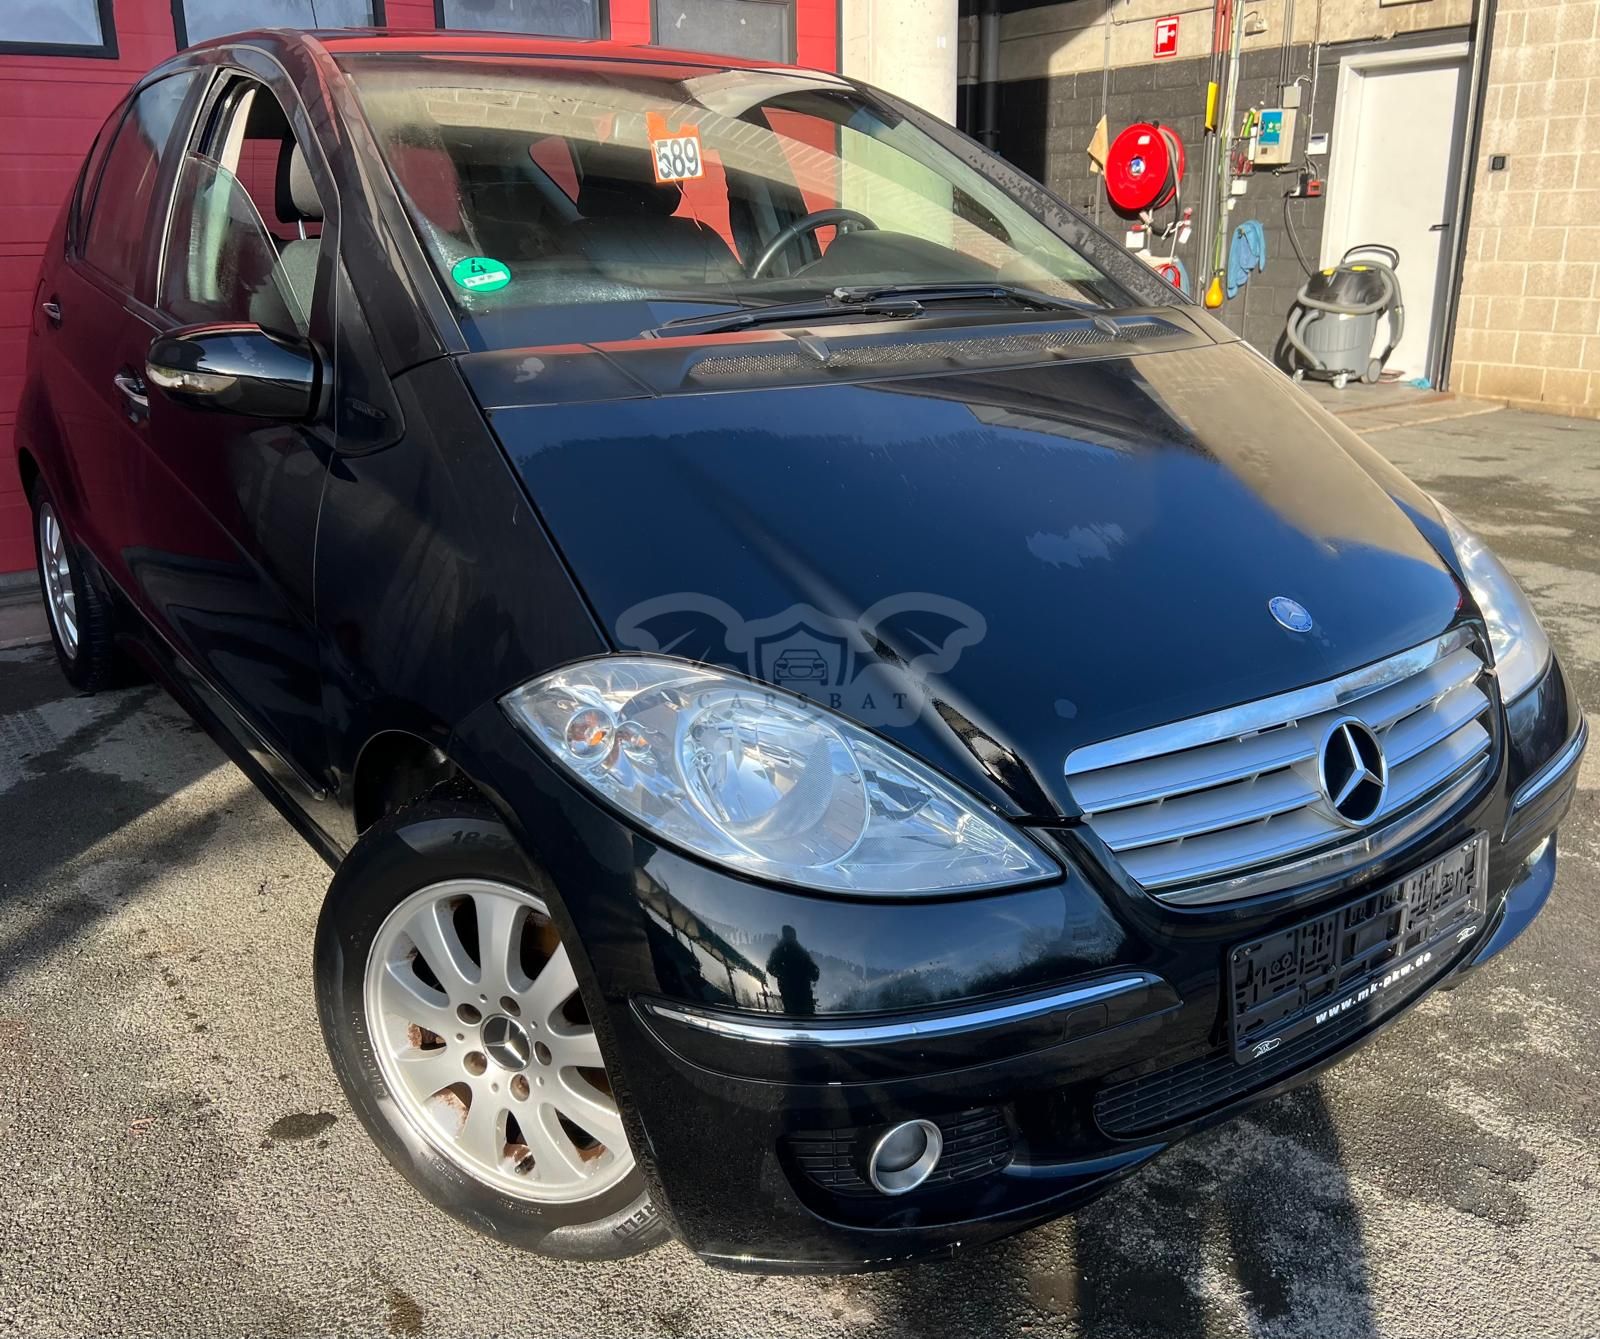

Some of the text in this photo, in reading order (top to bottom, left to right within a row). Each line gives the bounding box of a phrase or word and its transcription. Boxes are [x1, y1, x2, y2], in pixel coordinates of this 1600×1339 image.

[656, 138, 699, 178] 589
[471, 258, 488, 273] 4
[1315, 951, 1432, 1025] www.mk-pkw.de
